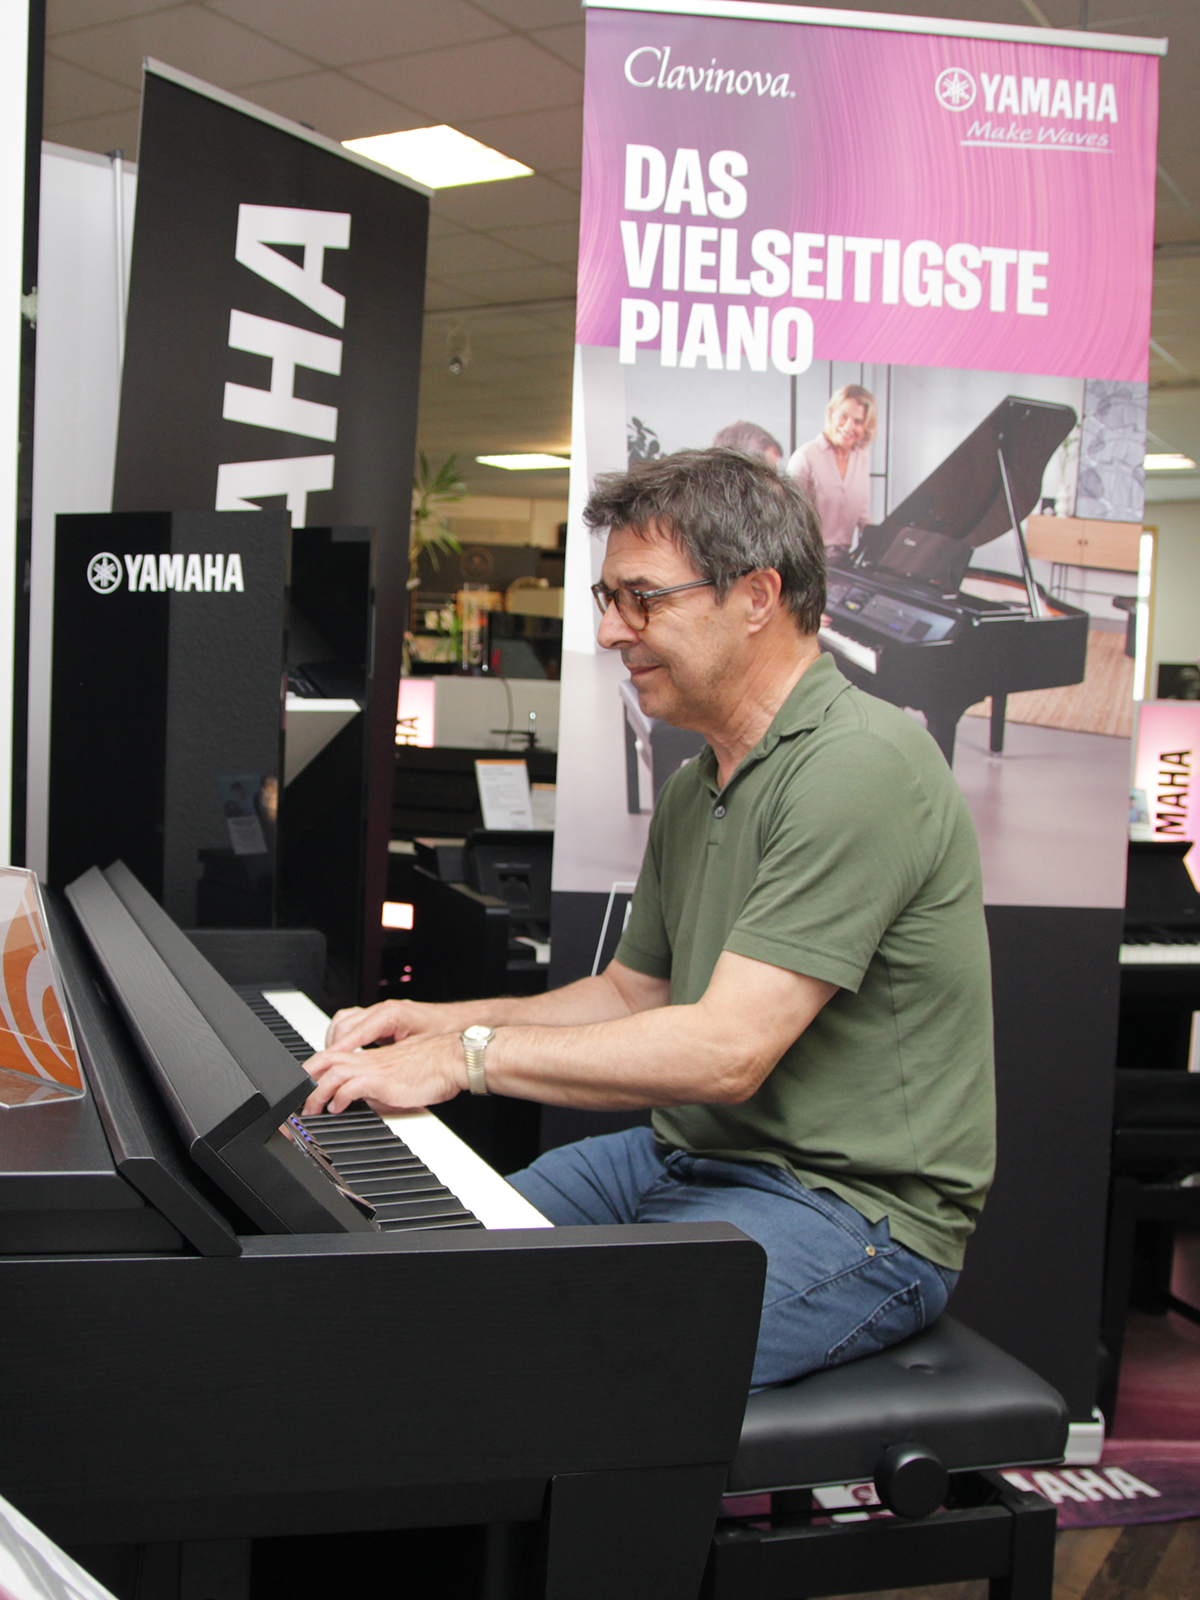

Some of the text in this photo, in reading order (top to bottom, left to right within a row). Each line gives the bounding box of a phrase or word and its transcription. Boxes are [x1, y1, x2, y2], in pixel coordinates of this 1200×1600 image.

[980, 72, 1118, 123] YAMAHA
[966, 120, 1109, 147] Make Waves
[624, 143, 748, 220] DAS
[620, 220, 1049, 317] VIELSEITIGSTE
[619, 297, 814, 375] PIANO
[123, 553, 244, 592] YAMAHA
